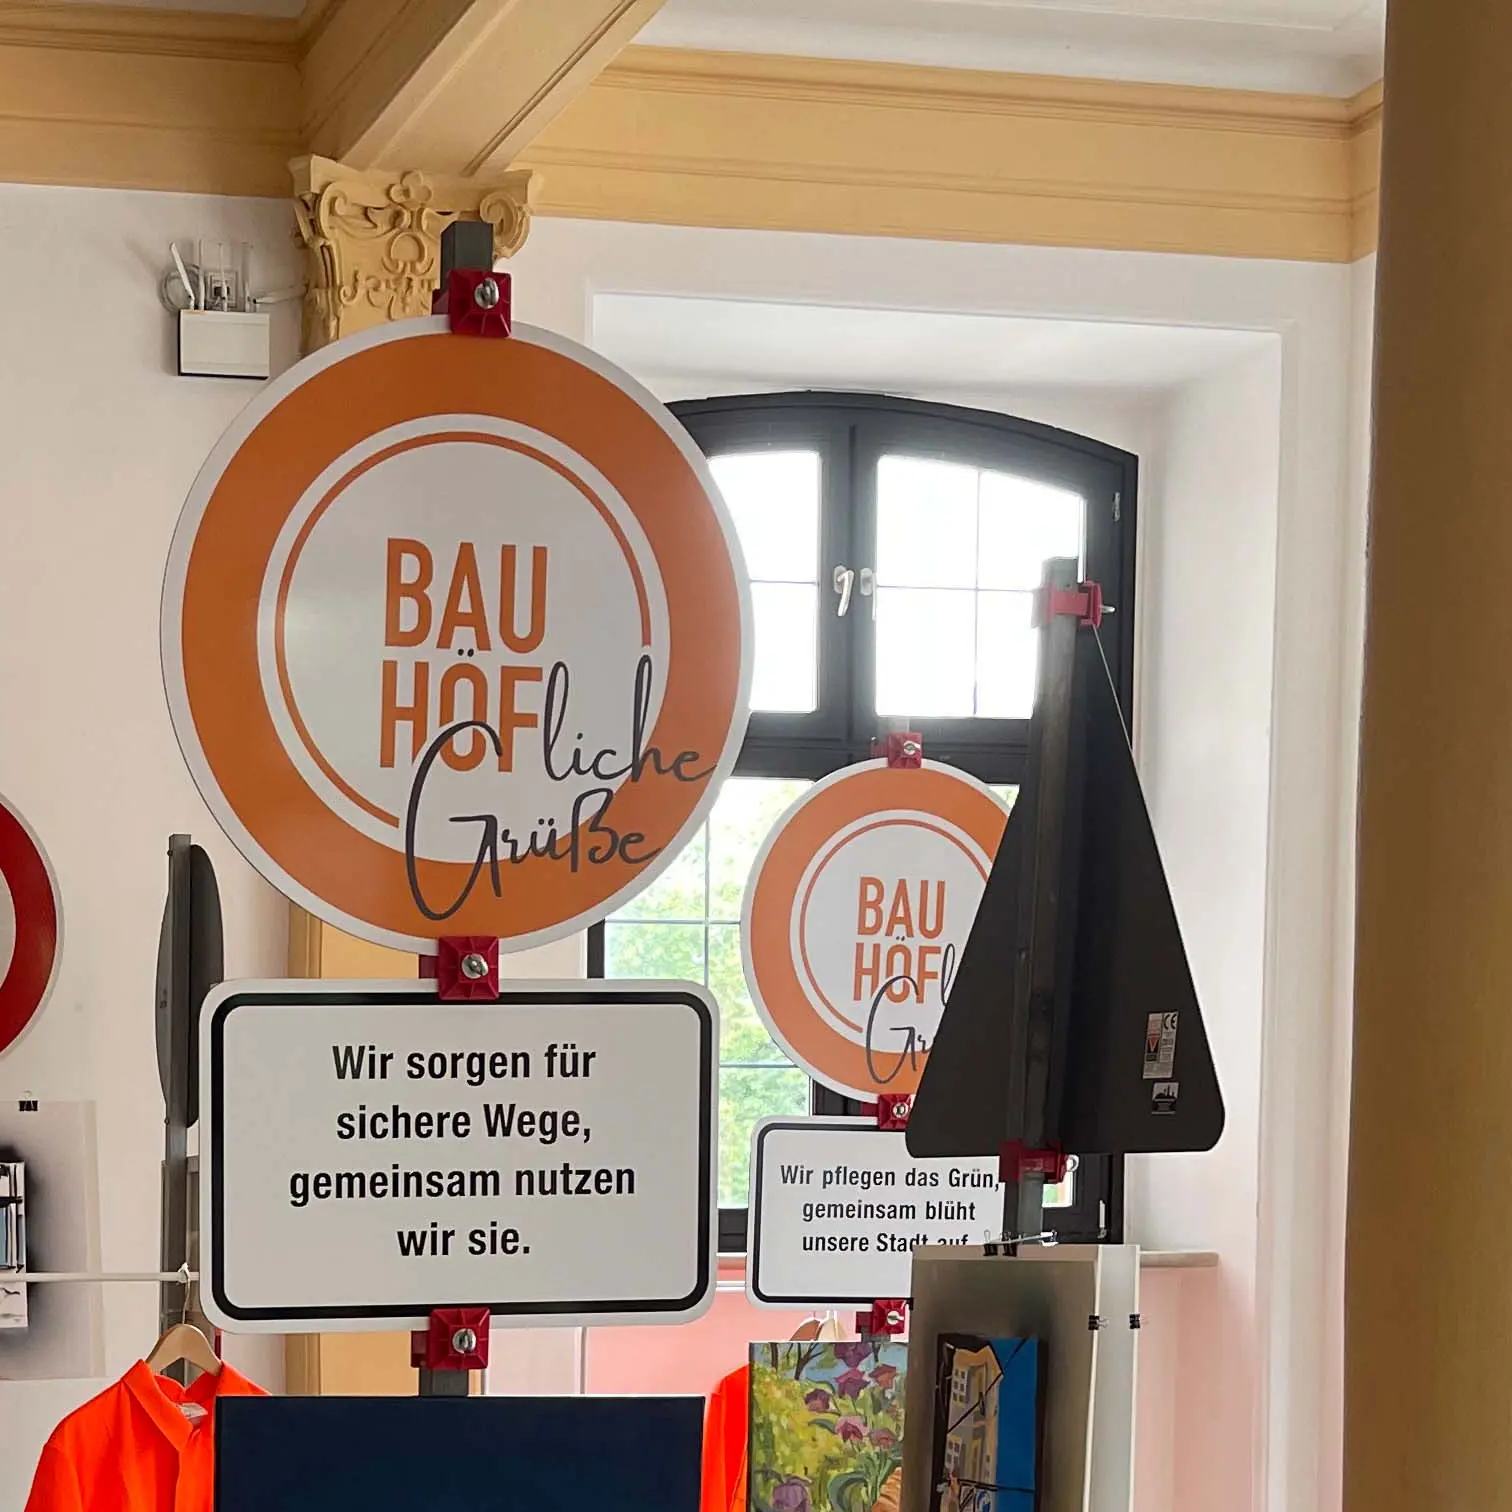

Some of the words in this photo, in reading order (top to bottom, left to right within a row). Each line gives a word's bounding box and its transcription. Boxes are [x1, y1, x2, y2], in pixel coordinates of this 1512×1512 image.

[383, 537, 548, 654] BAU
[405, 719, 665, 921] Grüße
[857, 875, 946, 939] BAU
[332, 1044, 394, 1080] Wir
[406, 1051, 530, 1087] sorgen
[544, 1043, 597, 1078] für
[336, 1104, 471, 1140] sichere
[483, 1103, 591, 1145] Wege,
[290, 1165, 500, 1208] gemeinsam
[515, 1162, 635, 1196] nutzen
[780, 1165, 814, 1185] Wir
[822, 1165, 896, 1190] pflegen
[905, 1167, 939, 1187] das
[948, 1167, 999, 1192] Grün,
[802, 1199, 916, 1223] gemeinsam
[925, 1200, 976, 1221] blüht
[396, 1221, 456, 1257] wir
[468, 1221, 531, 1256] sie.
[802, 1236, 869, 1252] unsere
